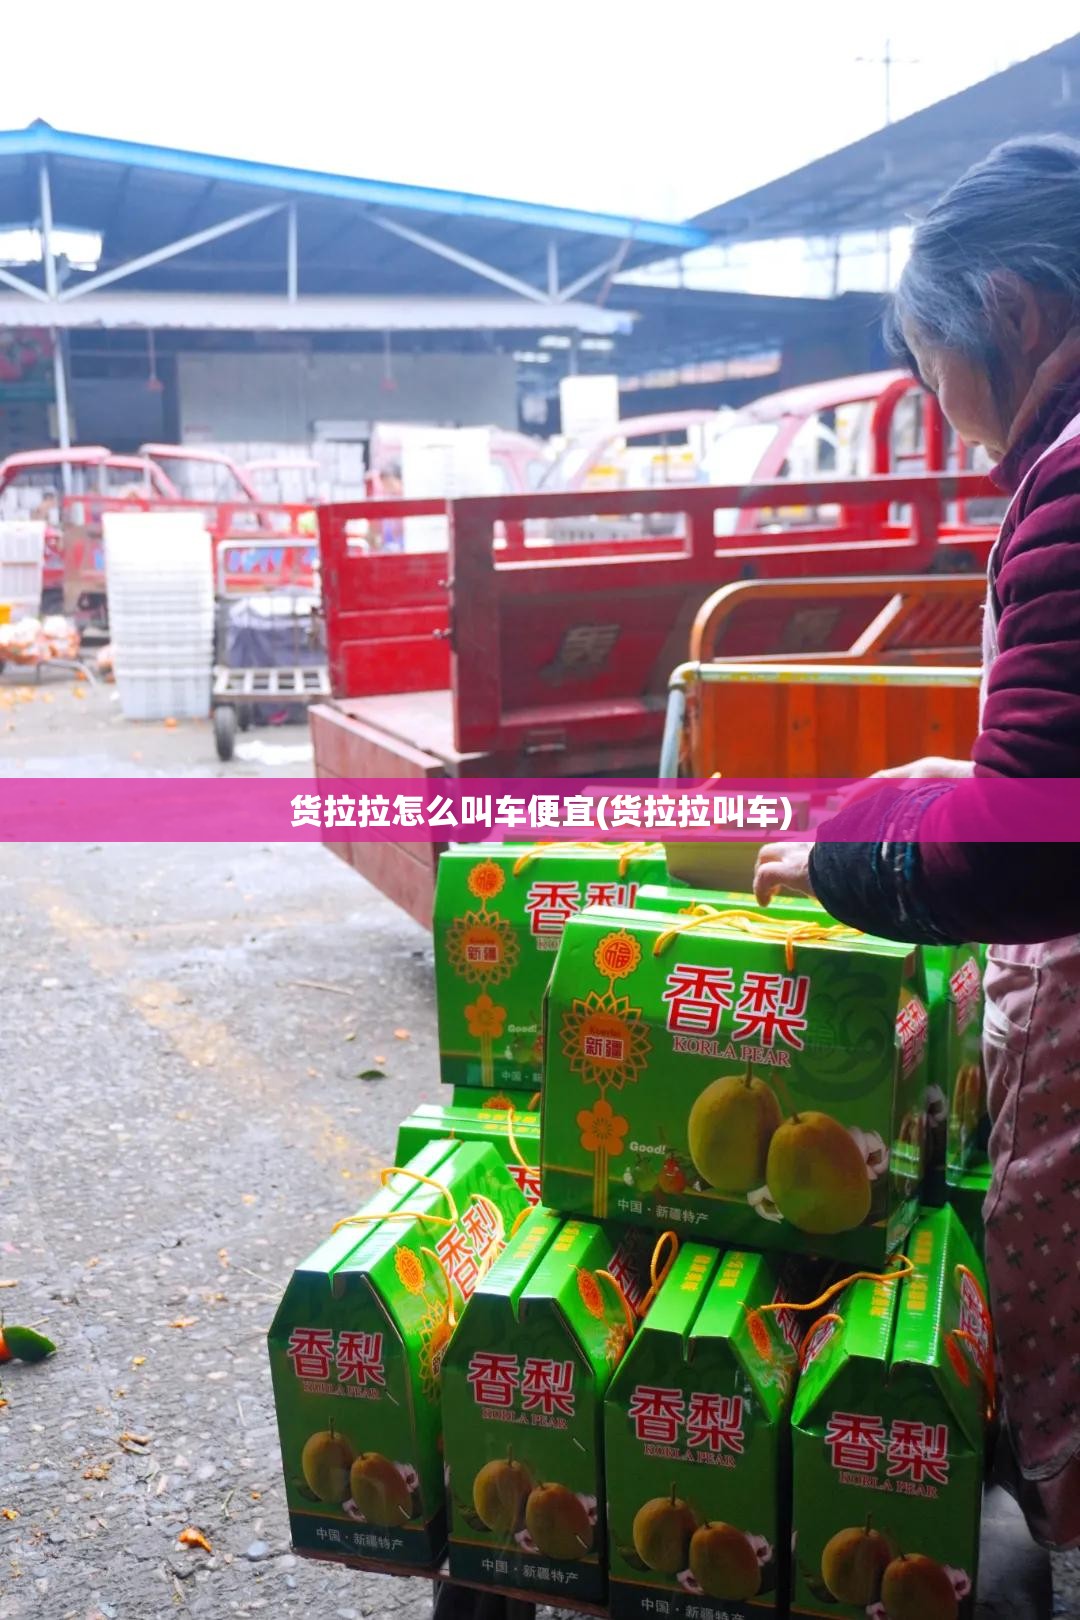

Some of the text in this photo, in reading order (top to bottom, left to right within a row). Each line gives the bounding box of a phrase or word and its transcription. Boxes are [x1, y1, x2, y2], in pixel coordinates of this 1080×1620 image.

[604, 940, 633, 970] 福
[663, 963, 810, 1050] 香梨
[585, 1036, 623, 1059] 新疆
[673, 1035, 791, 1068] KORLA PEAR
[629, 1141, 667, 1155] Good!
[287, 1327, 386, 1386] 香梨
[467, 1352, 575, 1416] 香梨
[628, 1385, 745, 1454] 香梨
[825, 1411, 950, 1485] 香梨
